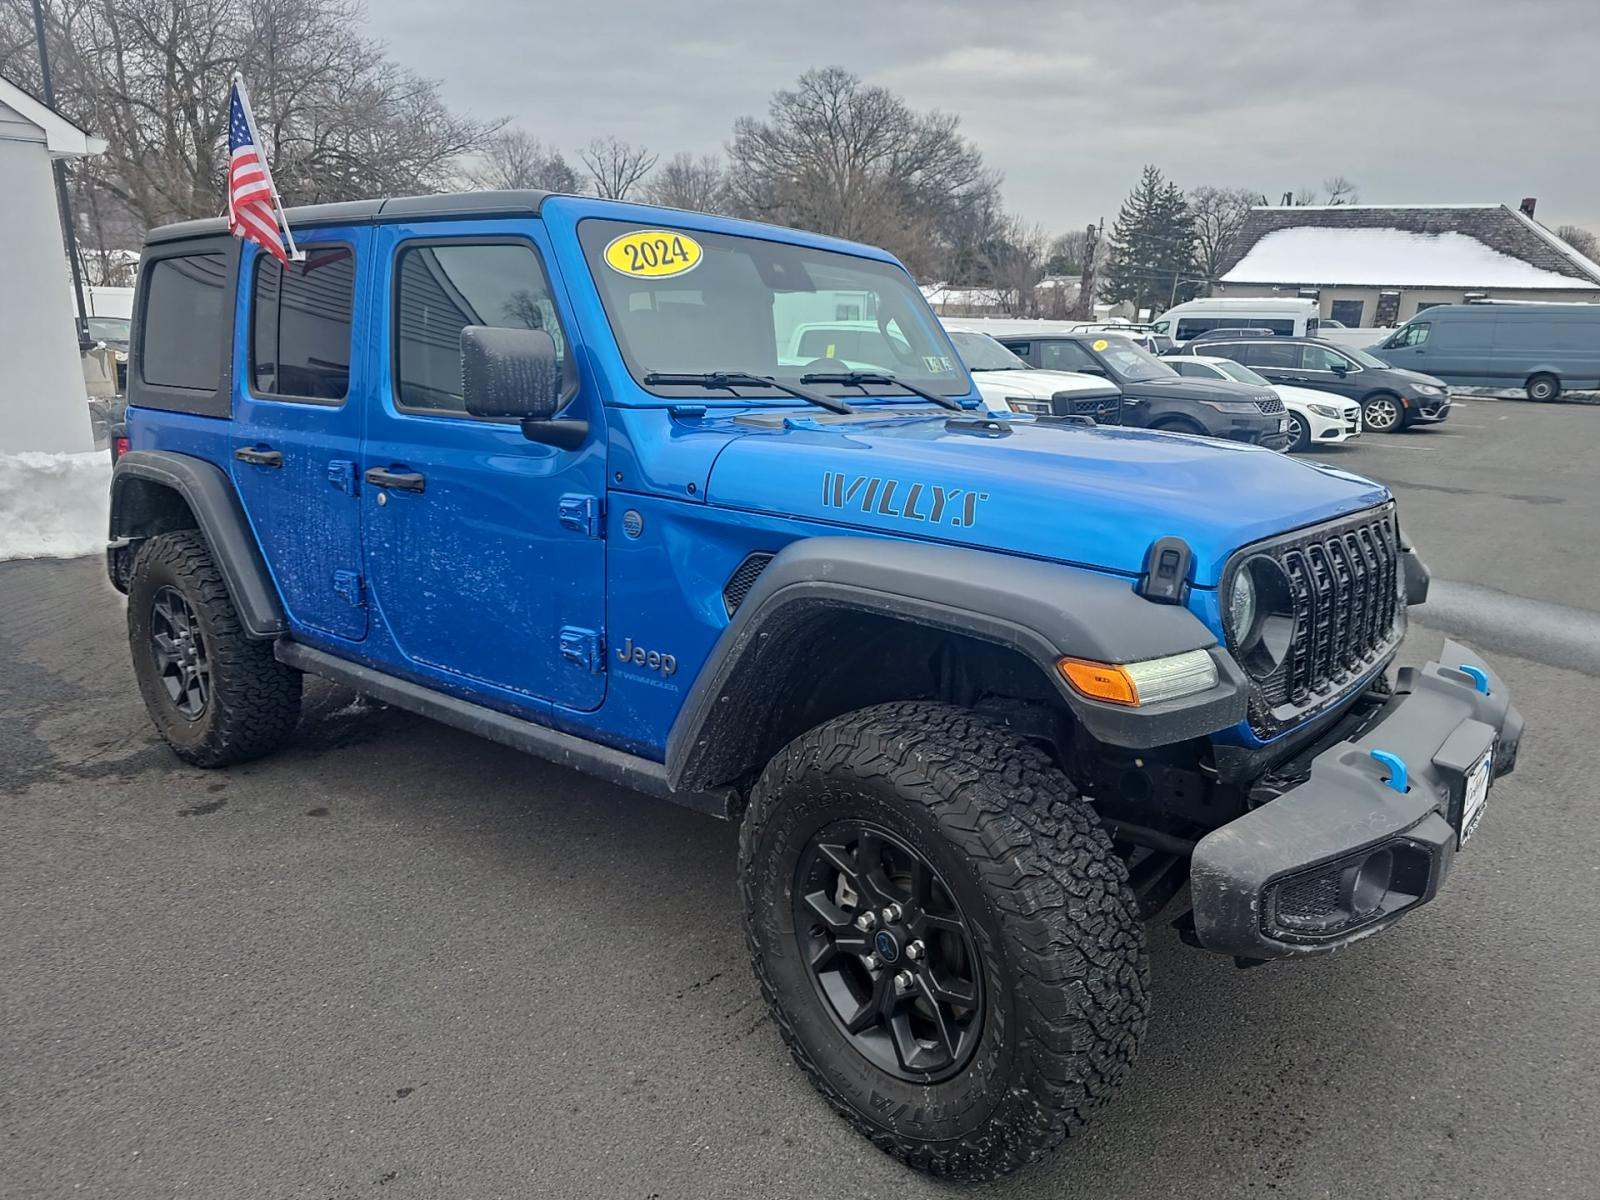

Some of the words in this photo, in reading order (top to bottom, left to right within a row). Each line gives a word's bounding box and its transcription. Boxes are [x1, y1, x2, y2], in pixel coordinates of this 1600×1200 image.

[624, 236, 690, 271] 2024
[821, 470, 990, 528] WILLYS
[615, 637, 677, 677] Jeep
